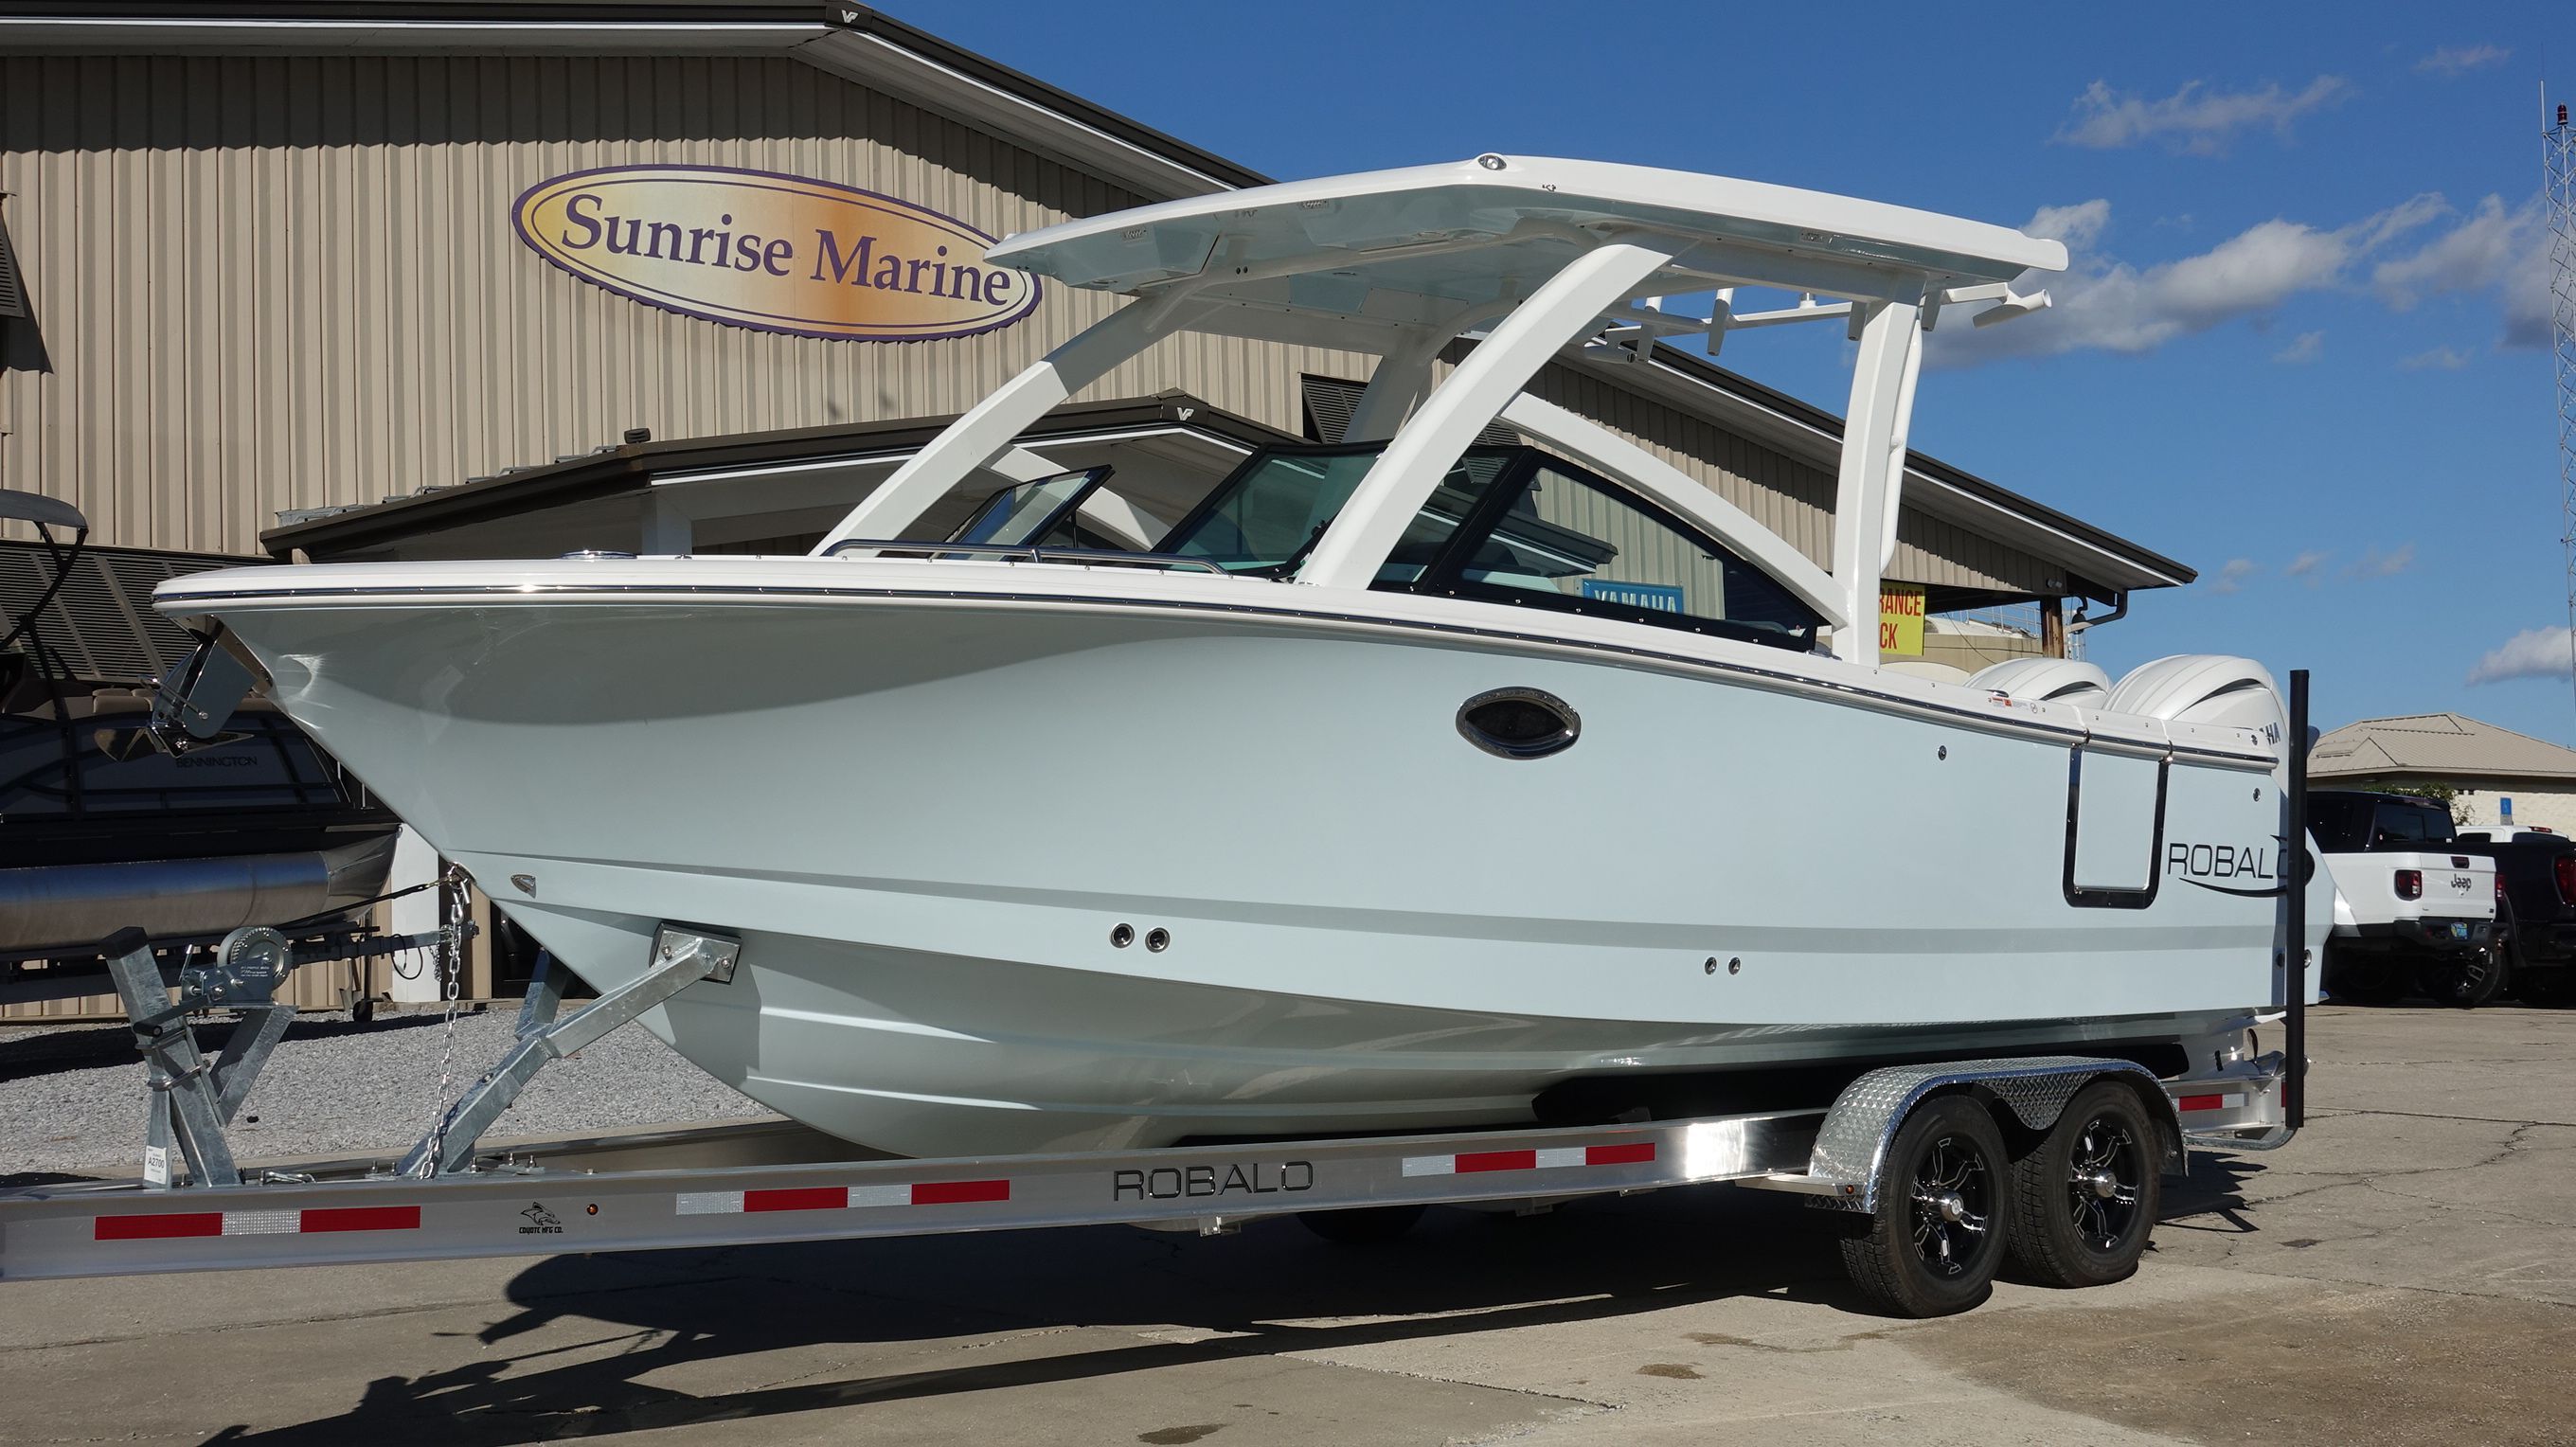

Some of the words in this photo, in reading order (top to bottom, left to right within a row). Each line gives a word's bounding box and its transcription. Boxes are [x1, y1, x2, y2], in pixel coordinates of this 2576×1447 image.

[561, 193, 794, 277] Sunrise
[810, 228, 1012, 306] Marine
[175, 756, 258, 768] BENNINGTON
[2450, 873, 2472, 892] Jeep
[1114, 1161, 1314, 1202] ROBALO
[519, 1226, 541, 1235] COYOTE
